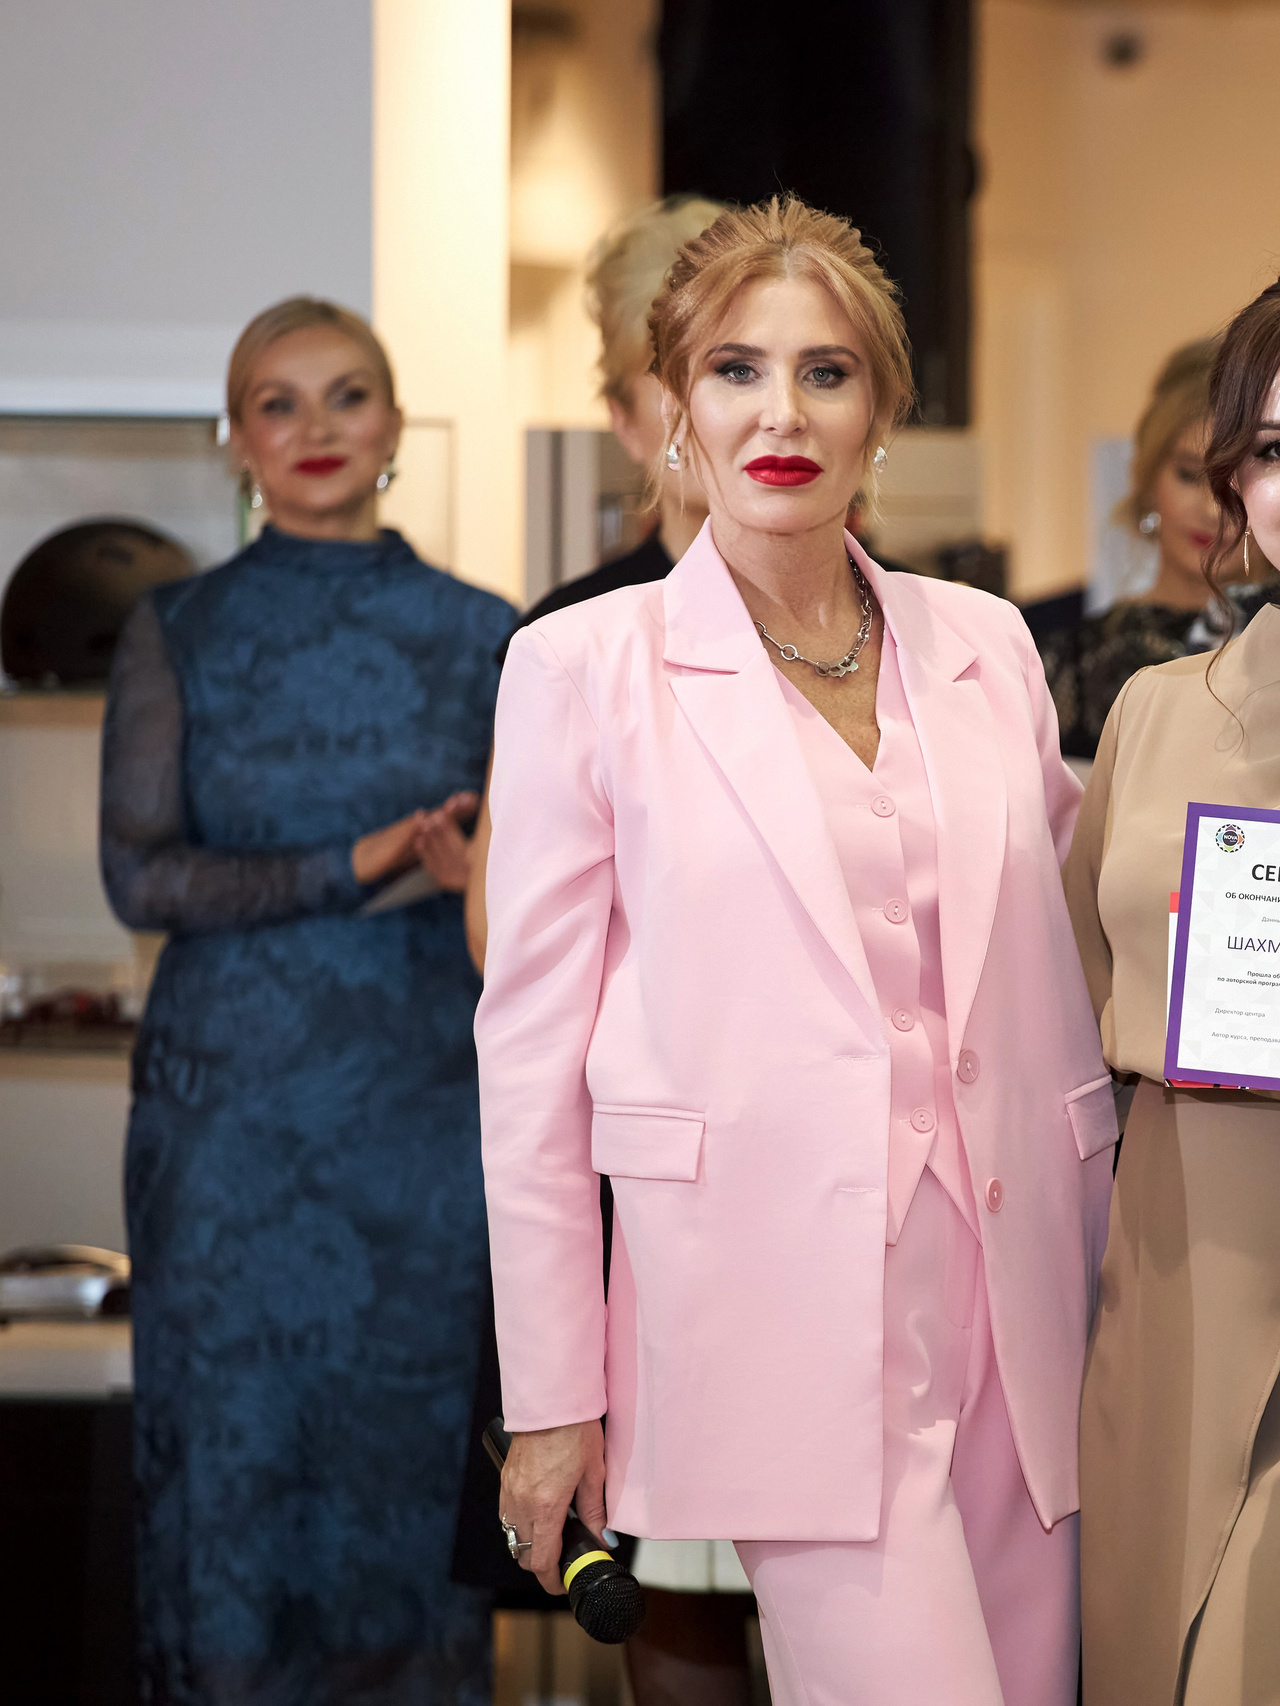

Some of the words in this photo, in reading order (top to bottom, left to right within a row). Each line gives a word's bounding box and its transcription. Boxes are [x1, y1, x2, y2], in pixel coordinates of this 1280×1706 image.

[1225, 891, 1237, 899] ОБ
[1226, 977, 1257, 985] авторской
[1214, 1007, 1243, 1016] Директор
[1211, 1031, 1229, 1039] Автор
